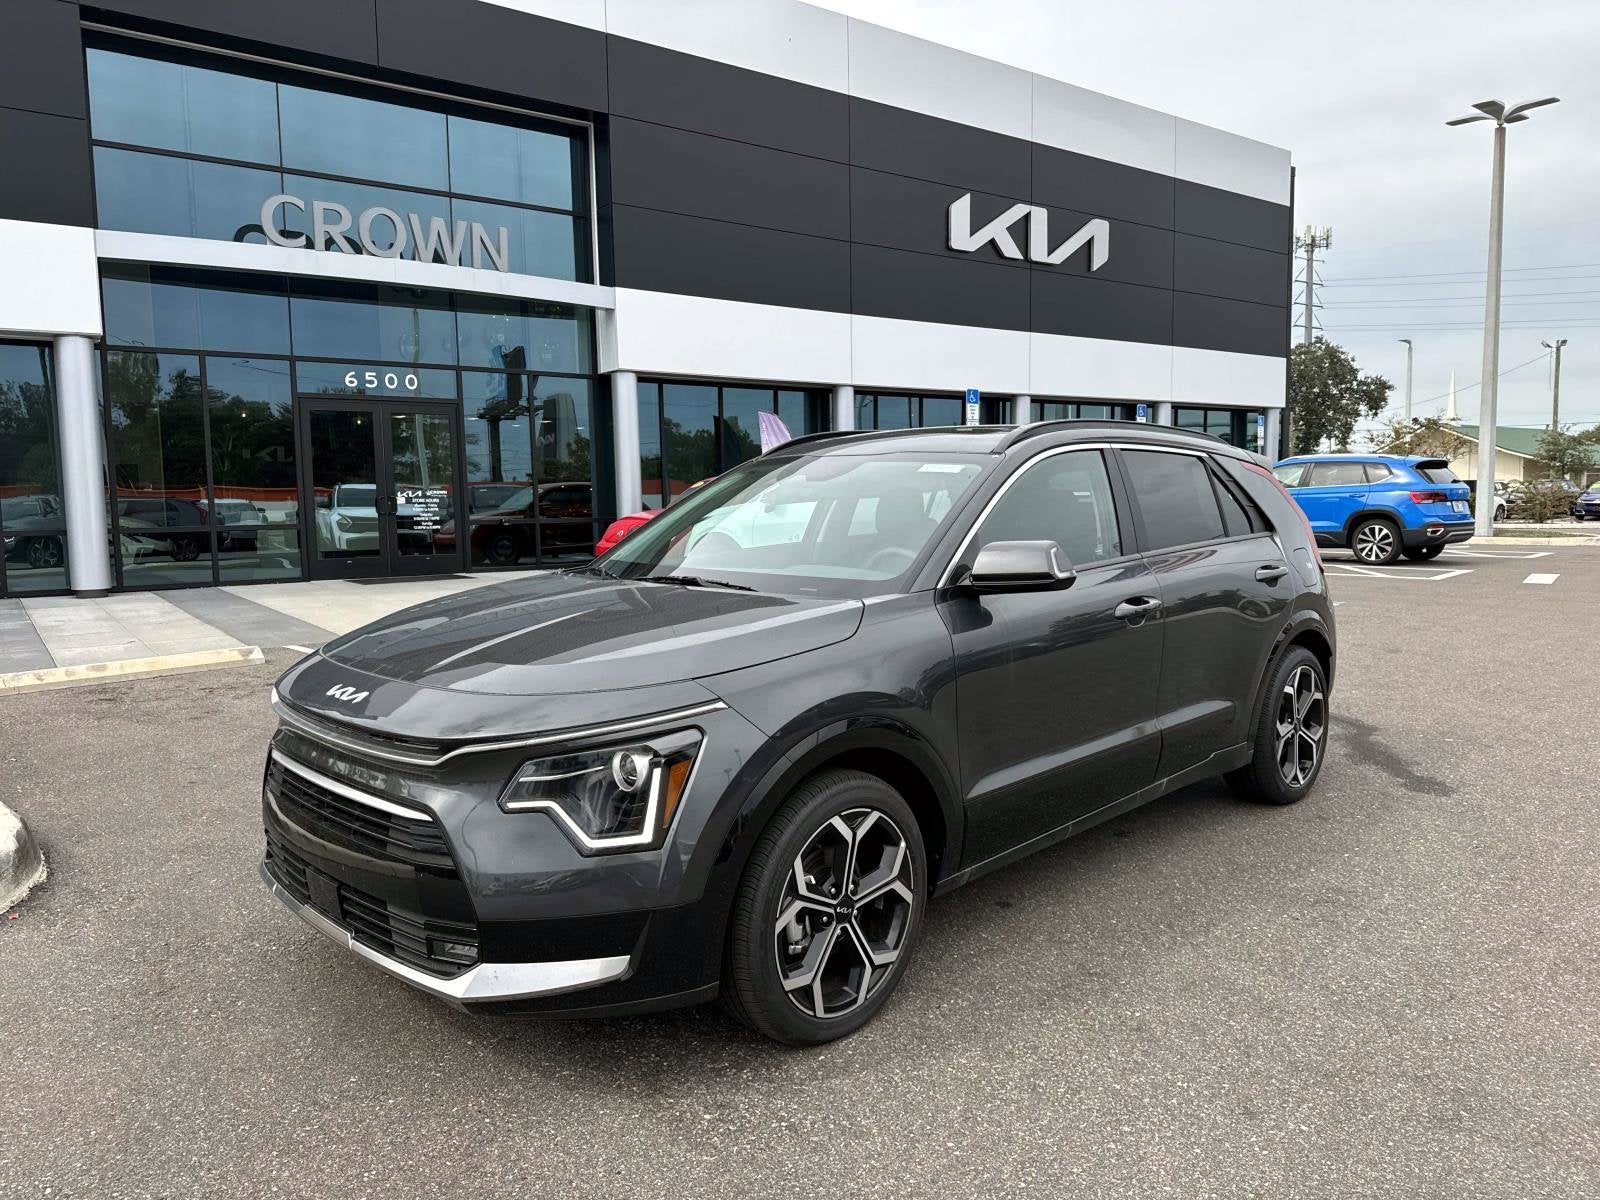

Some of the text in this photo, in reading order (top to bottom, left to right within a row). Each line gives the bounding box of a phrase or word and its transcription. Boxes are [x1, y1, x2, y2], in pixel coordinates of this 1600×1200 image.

[260, 194, 509, 273] CROWN
[948, 191, 1110, 272] KIA
[344, 371, 418, 390] 6500
[325, 683, 370, 704] KIA
[836, 906, 852, 914] KIA
